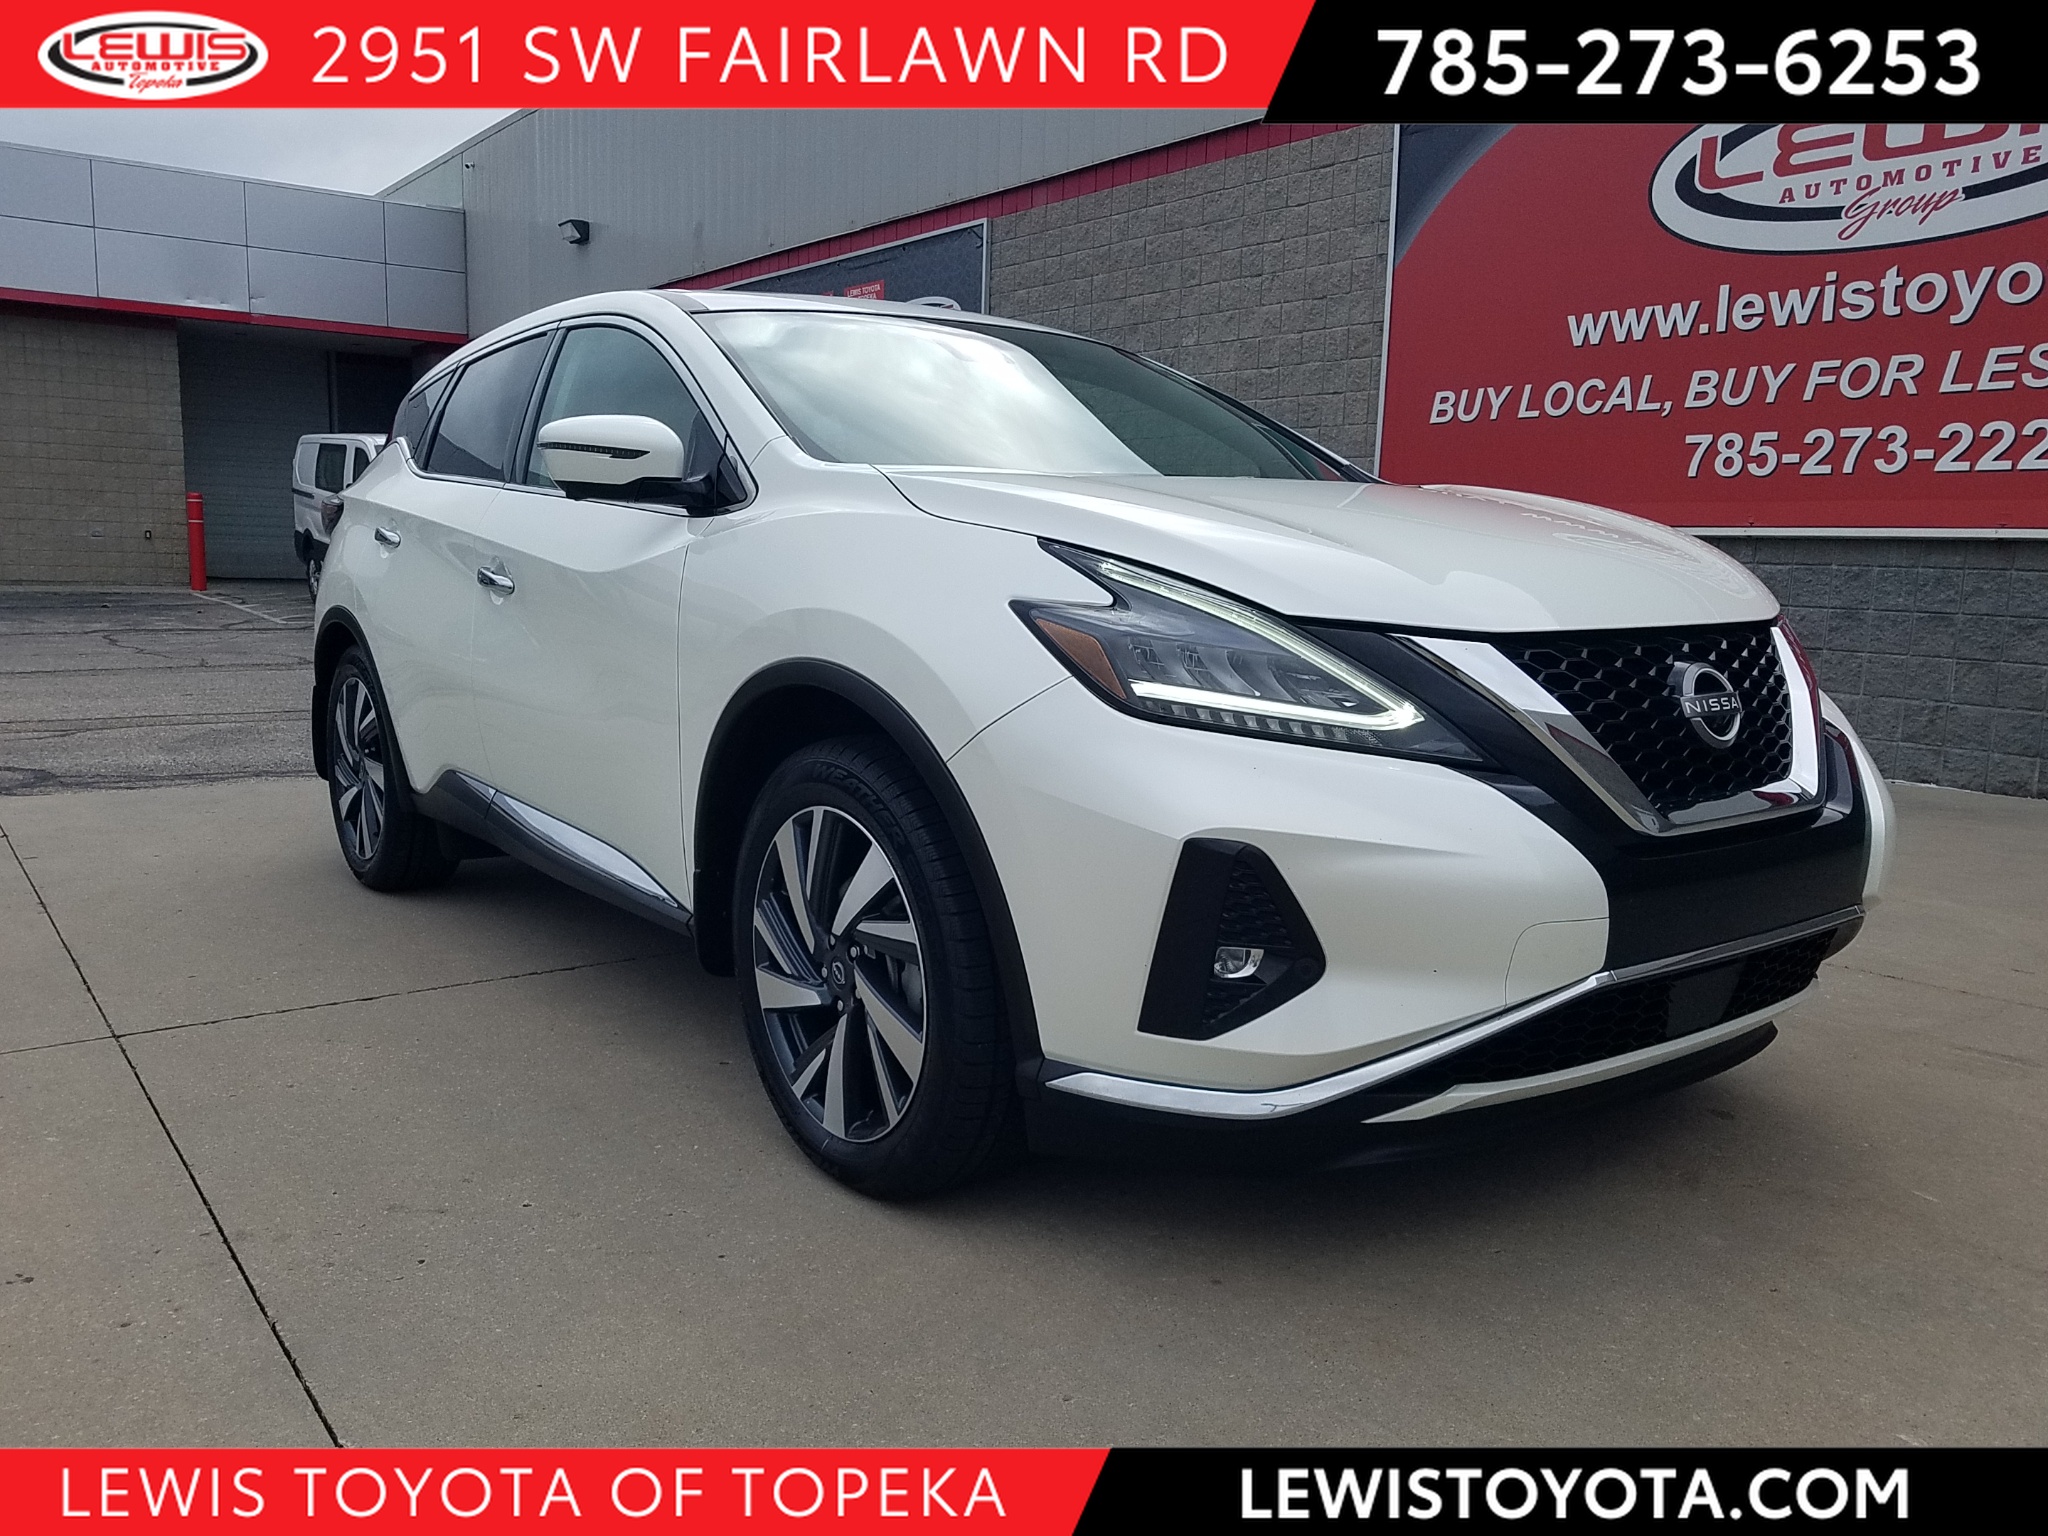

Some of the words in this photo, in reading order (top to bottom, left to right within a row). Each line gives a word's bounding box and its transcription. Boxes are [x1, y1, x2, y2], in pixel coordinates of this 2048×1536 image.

[1699, 123, 2041, 190] LEW
[1778, 145, 2043, 204] AUTOMOTIVE
[1838, 186, 1962, 241] Group
[862, 284, 881, 294] TOYOTA
[1428, 385, 1512, 424] BUY
[1516, 374, 1673, 418] LOCAL,
[1684, 362, 1797, 409] BUY
[1803, 353, 1926, 400] FOR
[1685, 418, 2048, 477] 785-273-222
